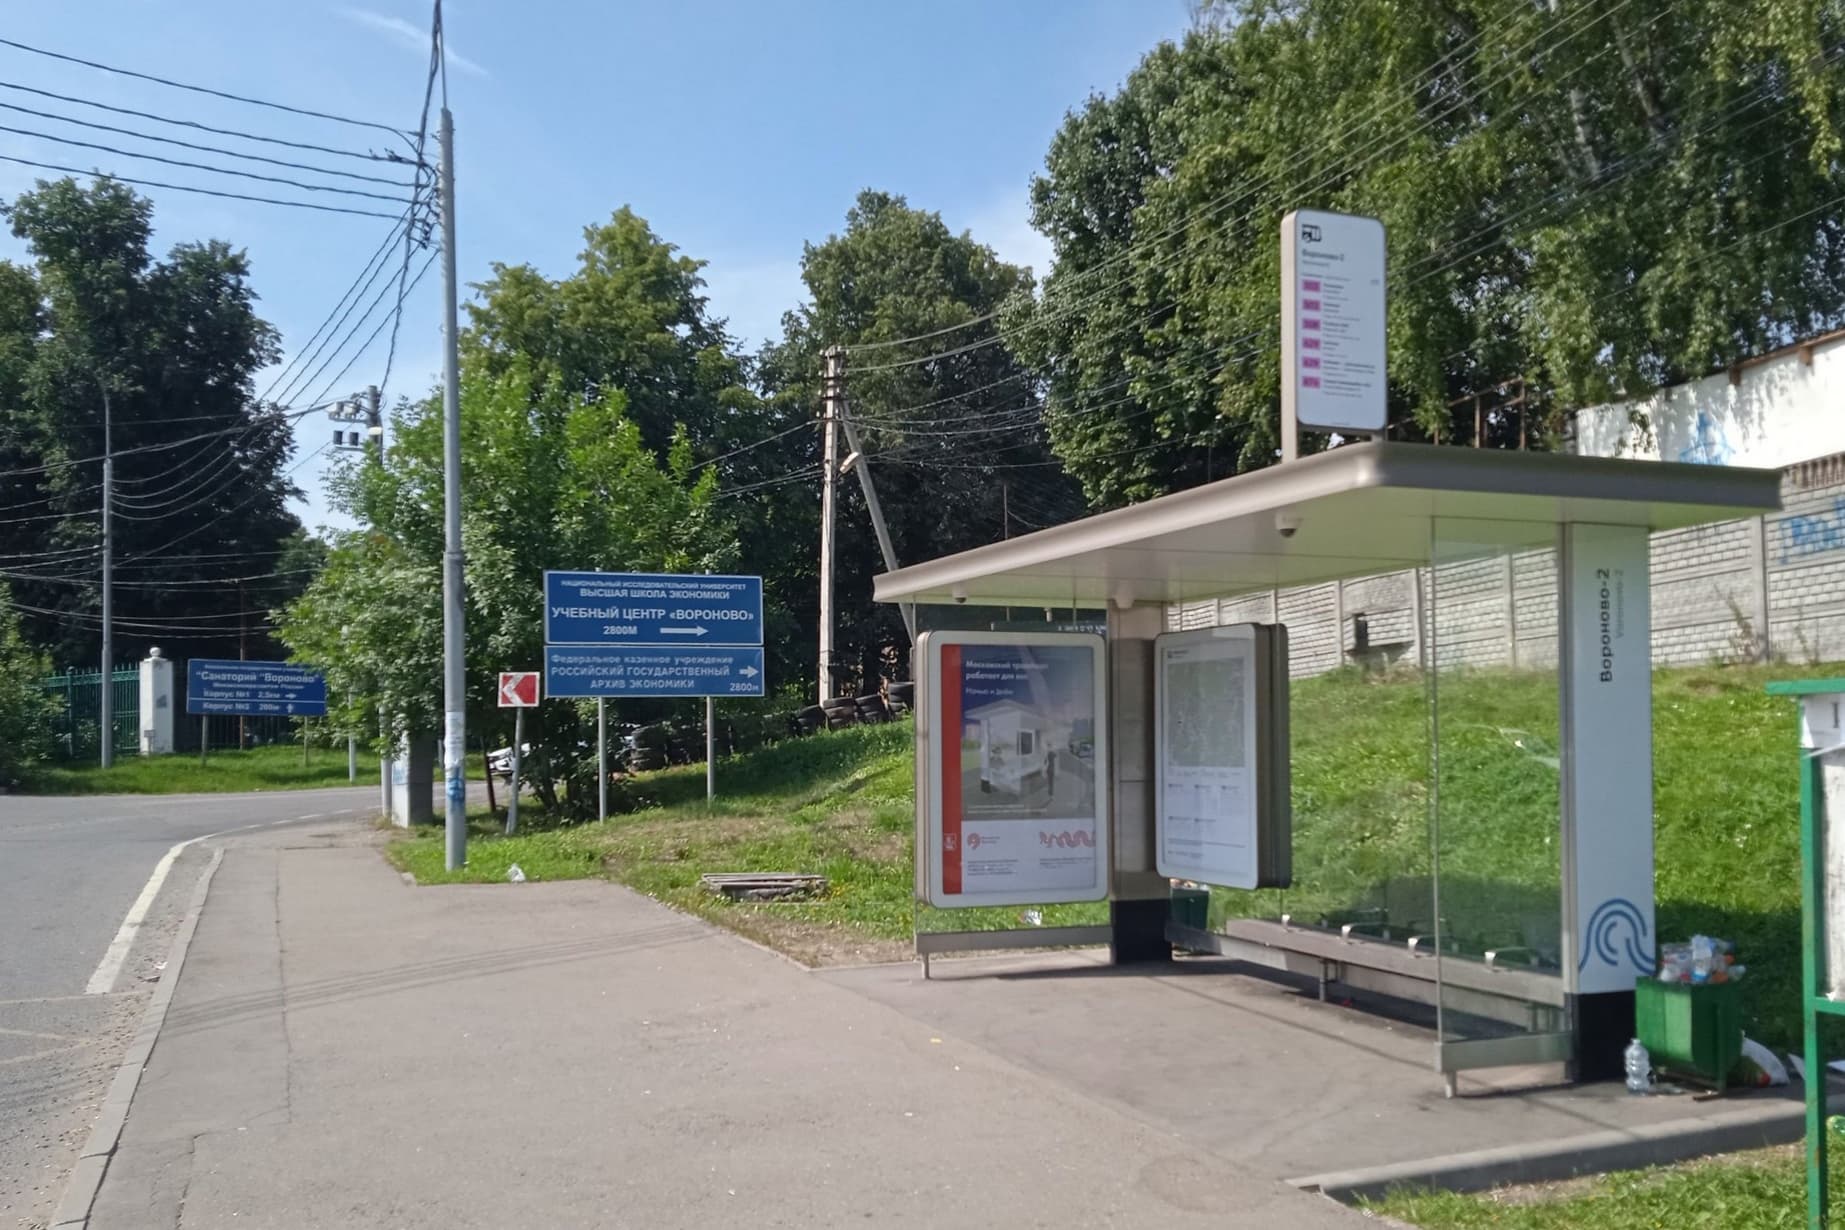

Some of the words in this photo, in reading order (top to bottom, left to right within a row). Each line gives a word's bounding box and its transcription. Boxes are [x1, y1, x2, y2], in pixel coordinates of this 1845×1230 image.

[580, 588, 628, 598] ВЫСШАЯ
[630, 589, 667, 598] ШКОЛА
[669, 590, 730, 600] ЭКОНОМИКИ
[552, 606, 619, 618] УЧЕБНЫЙ
[622, 608, 666, 620] ЦЕНТР
[669, 609, 754, 620] «ВОРОНОВО»
[1597, 568, 1614, 682] Вороново-2
[551, 655, 621, 664] Федеральное
[674, 657, 734, 665] учреждение
[551, 665, 624, 676] РОССИЙСКИЙ
[627, 665, 730, 676] ГОСУДАРСТВЕННЫЙ
[590, 680, 626, 688] АРХИВ
[629, 680, 695, 688] ЭКОНОМИКИ
[730, 682, 759, 691] 2800м
